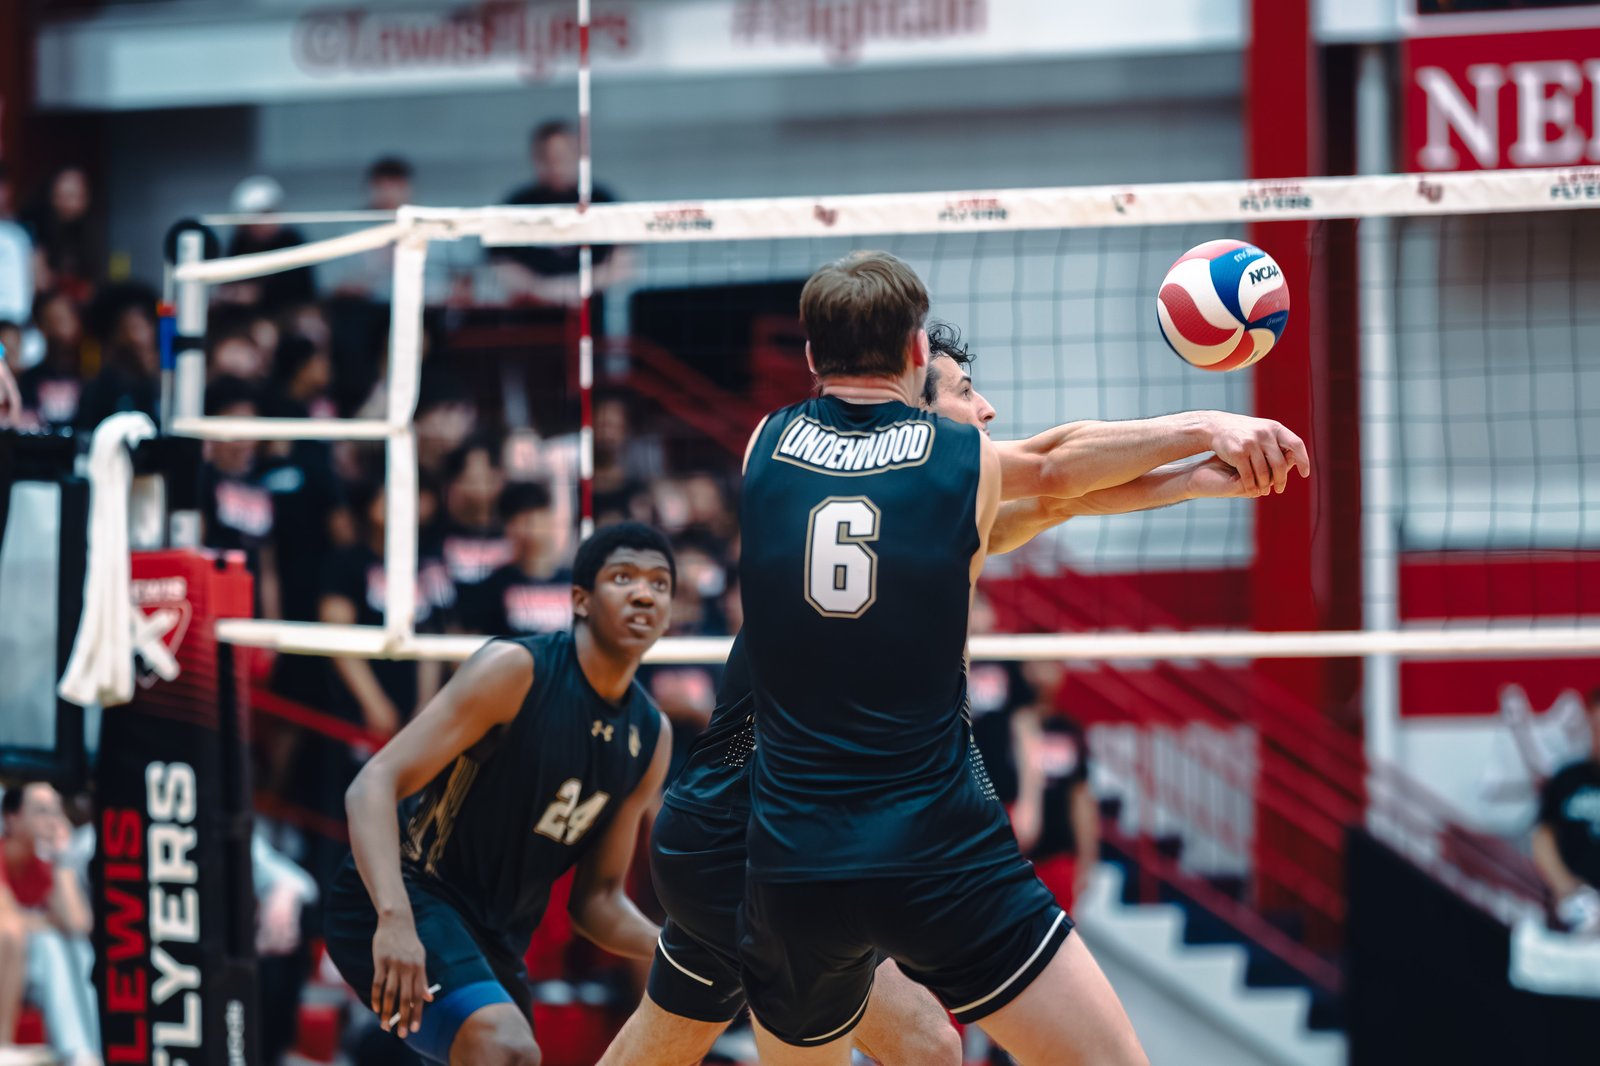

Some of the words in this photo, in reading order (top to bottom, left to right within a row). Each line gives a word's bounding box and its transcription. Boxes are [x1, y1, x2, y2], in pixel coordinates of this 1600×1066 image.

[776, 416, 933, 474] LINDENWOOD
[804, 496, 881, 619] 6
[533, 777, 610, 846] 24
[104, 808, 147, 1063] LEWIS
